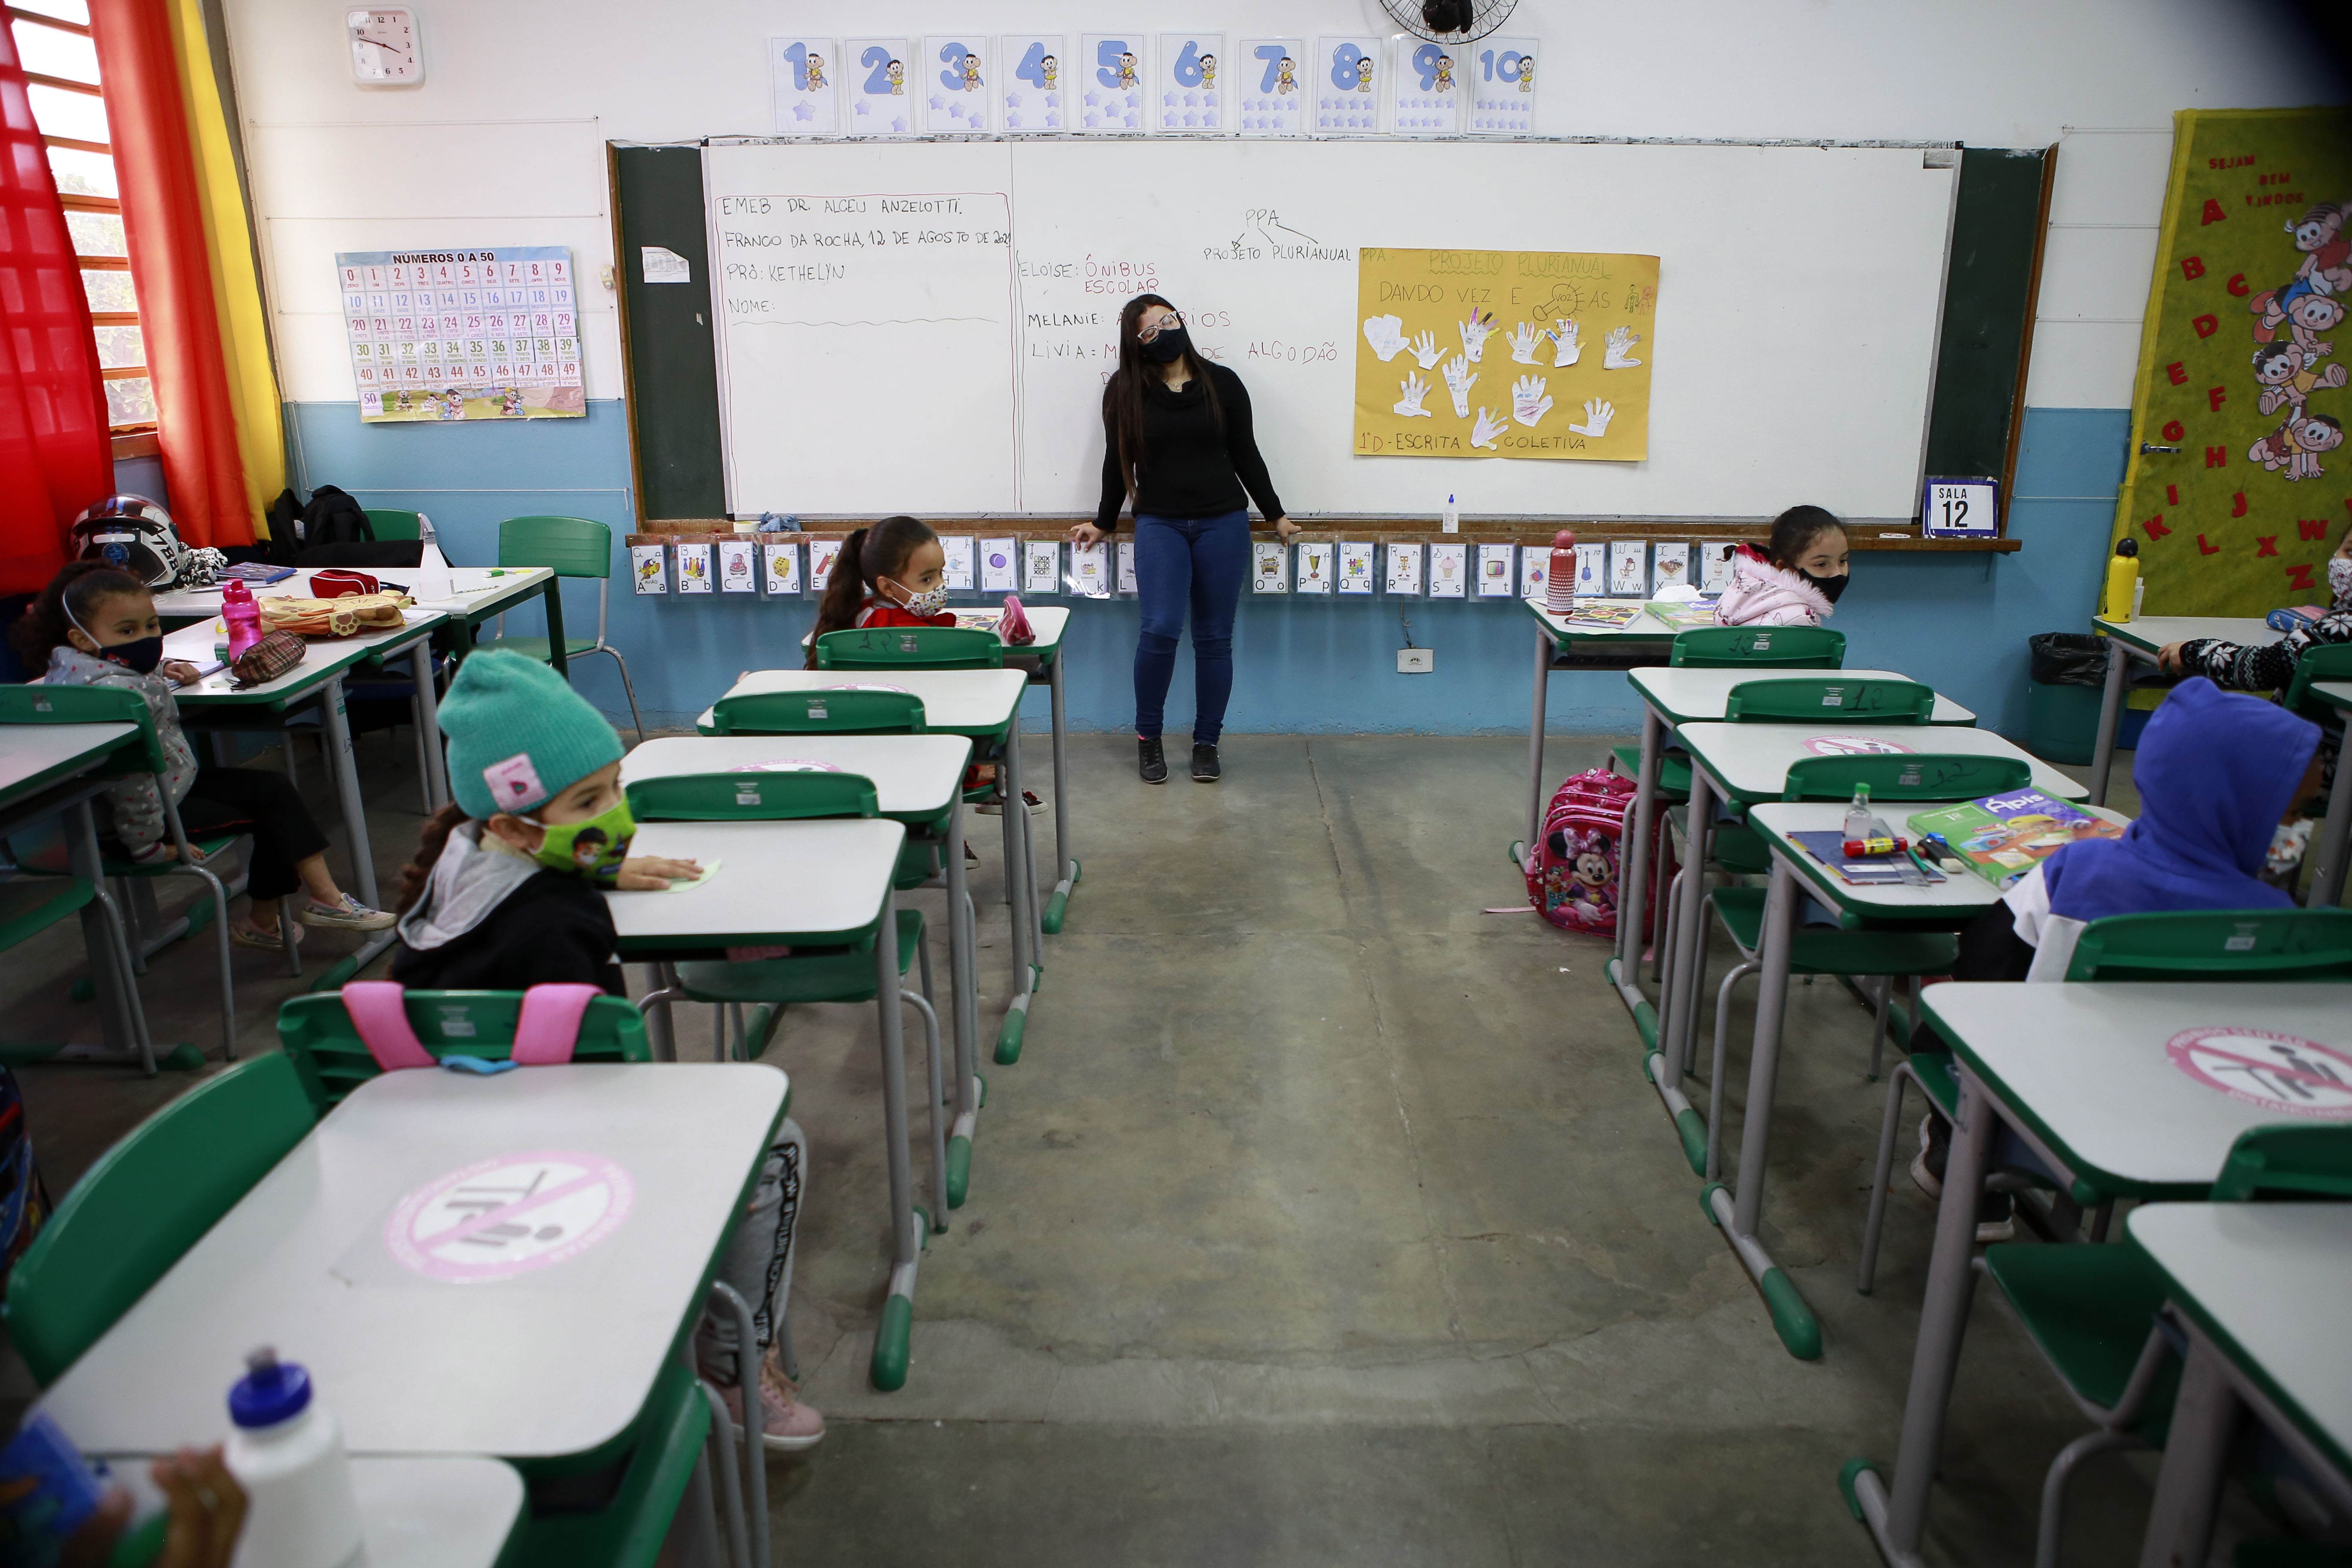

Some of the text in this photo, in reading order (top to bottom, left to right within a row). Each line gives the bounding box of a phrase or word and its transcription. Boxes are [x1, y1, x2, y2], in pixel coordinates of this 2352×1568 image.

[783, 42, 807, 91] 1
[861, 46, 893, 95] 2
[940, 42, 969, 91] 3
[1015, 42, 1045, 89] 4
[1096, 40, 1127, 89] 5
[1173, 40, 1204, 88] 6
[1253, 45, 1286, 94] 7
[1331, 43, 1362, 91] 8
[1412, 43, 1445, 92] 9
[1480, 49, 1524, 83] 10
[2208, 154, 2256, 170] SEJAM
[2259, 172, 2291, 186] BEM
[723, 198, 771, 215] EMEB
[787, 198, 811, 213] DR.
[824, 199, 867, 214] ALCEU
[2245, 193, 2304, 207] VINDOS
[1246, 209, 1279, 228] PPA
[2201, 198, 2227, 226] A
[791, 233, 807, 247] DA
[814, 232, 864, 249] ROCHA,
[868, 230, 885, 246] 12
[893, 231, 910, 245] DE
[918, 231, 969, 244] AGOSTO
[975, 232, 989, 244] DE
[392, 252, 494, 264] NÚMEROS 0 A 50
[1204, 242, 1351, 261] PROJETO PLURIANUAL
[1085, 253, 1155, 277] ÔNIBUS
[1361, 248, 1386, 262] PPA
[1429, 250, 1504, 271] PROJETO
[1518, 252, 1611, 276] PLURIANUAL
[2180, 256, 2205, 281] B
[347, 263, 562, 281] 0 1 2 3 4 5 6 7 8 9
[769, 263, 845, 282] KETHELYN
[1085, 278, 1159, 294] ESCOLAR
[1380, 281, 1444, 303] DANDO
[1457, 288, 1491, 303] VEZ
[1511, 287, 1522, 305] E
[1554, 293, 1574, 302] VOZ
[2227, 273, 2250, 297] C
[349, 290, 567, 308] 10 11 12 13 14 15 16 17 18 19
[729, 299, 775, 314] NOME:
[352, 313, 571, 331] 20 29
[1028, 312, 1104, 328] MELANIE:
[2192, 314, 2219, 340] D
[356, 338, 573, 356] 30 39
[1202, 346, 1225, 360] DE
[1248, 340, 1338, 365] ALGODÃO
[360, 363, 576, 380] 40 49
[2166, 361, 2189, 386] E
[364, 393, 377, 404] 50
[2208, 386, 2226, 413] F
[2162, 420, 2184, 442] G
[1396, 432, 1460, 450] ESCRITA
[1504, 435, 1586, 451] COLETIVA
[2206, 445, 2226, 469] H
[1939, 488, 1967, 499] SALA
[2166, 484, 2178, 506] I
[1943, 500, 1968, 527] 12
[2232, 491, 2248, 518] J
[2142, 514, 2172, 542] K
[2298, 519, 2329, 541] W
[2197, 533, 2220, 556] L
[2256, 535, 2279, 557] X
[637, 582, 646, 592] A
[682, 581, 689, 591] B
[724, 579, 732, 589] C
[769, 581, 778, 591] D
[813, 577, 820, 588] E
[1027, 579, 1032, 589] J
[1120, 579, 1127, 590] L
[1255, 579, 1265, 590] O
[1299, 578, 1307, 588] P
[1340, 579, 1350, 589] Q
[1388, 579, 1396, 590] R
[1433, 582, 1439, 592] S
[1613, 580, 1626, 591] W
[1703, 580, 1711, 591] Y
[2285, 564, 2315, 591] Z
[1480, 583, 1488, 593] T
[1523, 585, 1531, 595] U
[1984, 794, 2045, 813] Ápis
